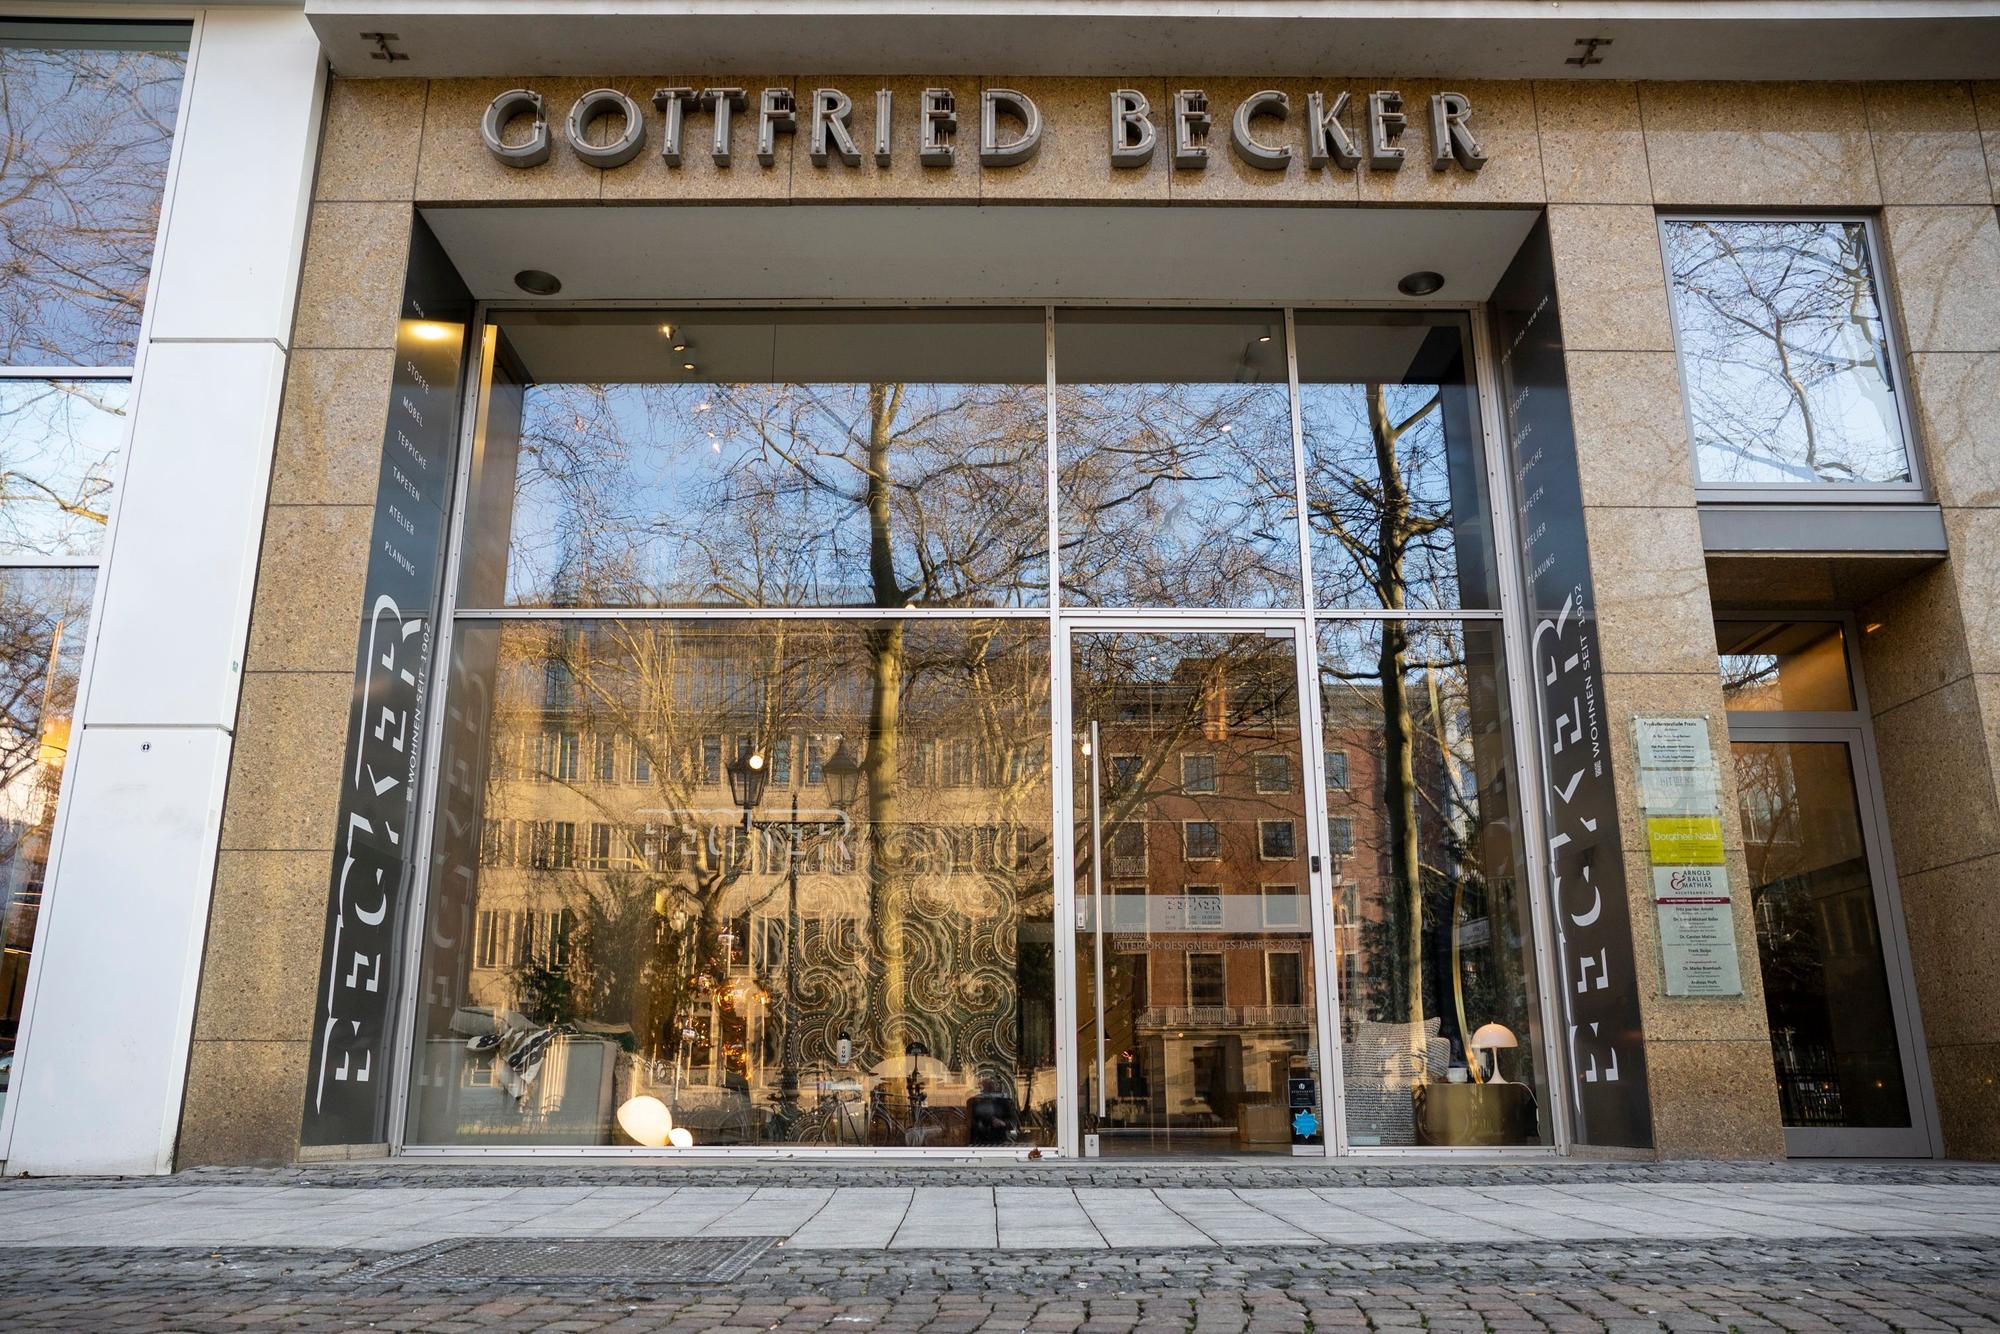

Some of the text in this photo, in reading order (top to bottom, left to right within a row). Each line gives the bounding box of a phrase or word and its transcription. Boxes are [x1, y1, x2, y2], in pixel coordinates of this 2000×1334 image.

[479, 87, 1489, 171] GOTTFRIED BECKER
[406, 361, 430, 394] STOFFE
[1508, 386, 1529, 418] STOFFE
[397, 430, 427, 470] TEPPICHE
[1516, 447, 1543, 483] TEPPICHE
[392, 465, 420, 502] TAPETEN
[1520, 486, 1544, 517] TAPETEN
[388, 504, 415, 536] ATELIER
[1524, 522, 1546, 552] ATELIER
[384, 541, 416, 576] PLANUNG
[1527, 553, 1556, 587] PLANUNG
[1574, 583, 1600, 758] WOHNEN SEIT 1902
[408, 622, 431, 784] WOHNEN SEIT 1902
[315, 593, 423, 1115] BECKER
[1532, 591, 1620, 1115] BECKER
[1114, 940, 1302, 951] INTERIOR DESIGNER DES JAHRES 2023
